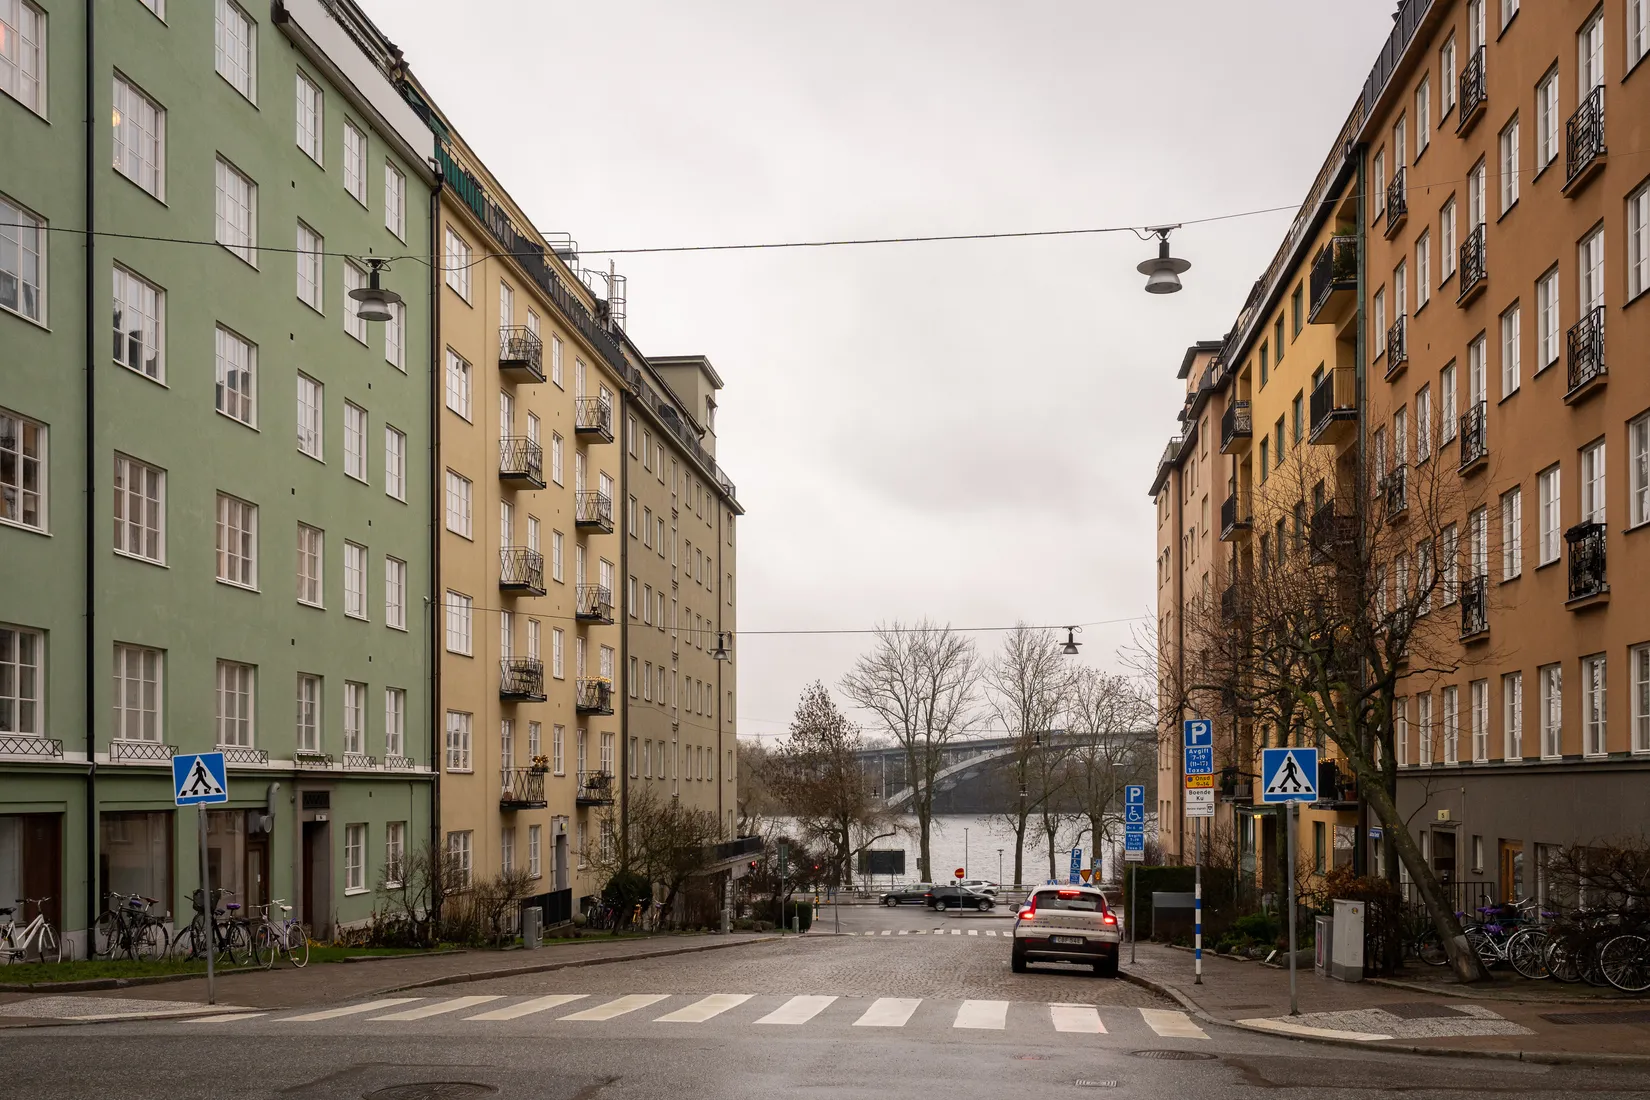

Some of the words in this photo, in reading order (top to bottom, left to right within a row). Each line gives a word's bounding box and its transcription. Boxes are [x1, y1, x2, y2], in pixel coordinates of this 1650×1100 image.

[1191, 722, 1207, 744] P
[1130, 787, 1141, 802] P
[1074, 849, 1081, 857] P
